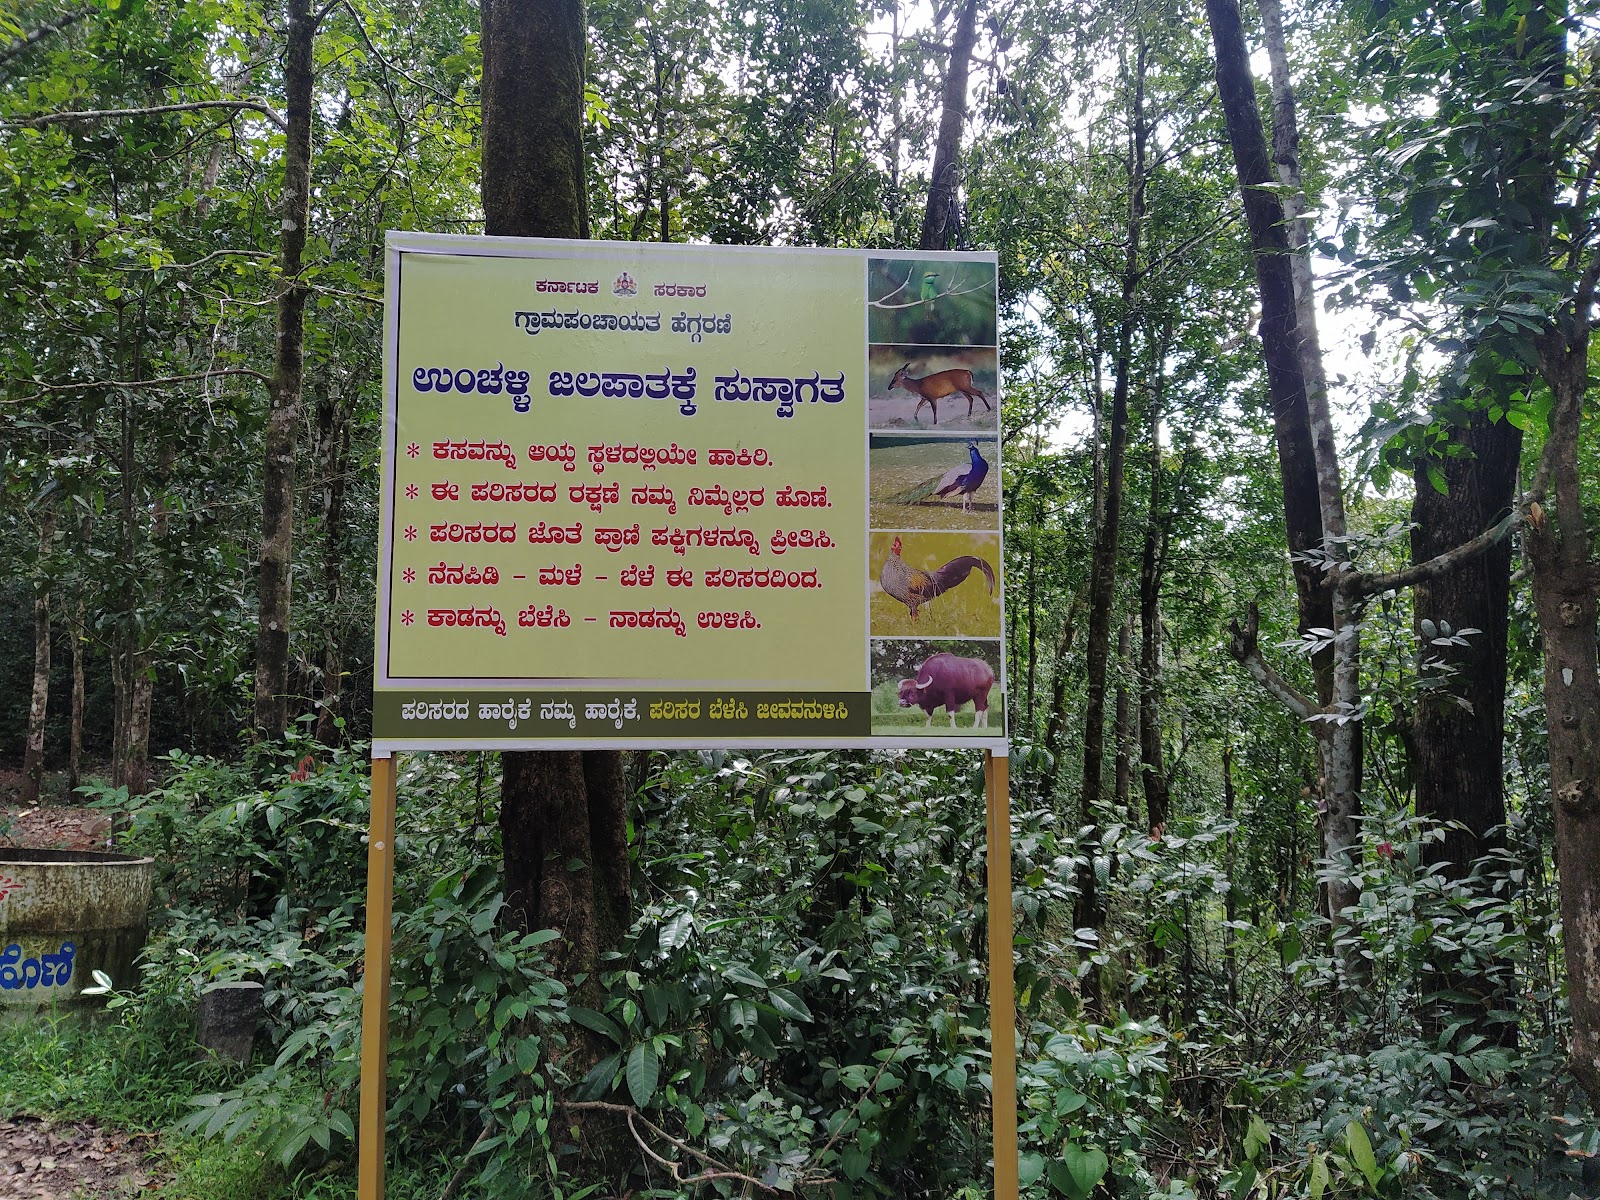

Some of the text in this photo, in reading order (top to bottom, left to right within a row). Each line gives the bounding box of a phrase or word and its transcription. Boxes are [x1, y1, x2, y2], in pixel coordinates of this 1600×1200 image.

[535, 277, 707, 299] ಕರ್ನಾಟಕ ಸರಕಾರ
[514, 308, 732, 343] ಗ್ರಾಮಪಂಚಾಯತ ಹೆಗ್ಗರಣಿ
[412, 361, 846, 419] ಉಂಚಳ್ಳಿ ಜಲಪಾತಕ್ಕೆ ಸುಸ್ವಾಗತ
[432, 438, 774, 475] ಕಸವನ್ನು ಆಯ್ದ ಸ್ಥಳದಲ್ಲಿಯೇ ಹಾಕಿರಿ.
[431, 479, 833, 516] ಈ ಪರಿಸರದ ರಕ್ಷಣೆ ನಮ್ಮ ನಿಮ್ಮೆಲ್ಲರ ಹೊಣೆ.
[429, 521, 837, 557] ಪರಿಸರದ ಜೊತೆ ಪ್ರಾಣಿ ಪಕ್ಷಿಗಳನ್ನೂ ಪ್ರೀತಿಸಿ.
[428, 561, 500, 586] ನೆನಪಿಡಿ
[539, 563, 582, 587] ಮಳೆ
[620, 564, 656, 588] ಬೆಳೆ
[666, 565, 694, 589] ಈ
[704, 566, 823, 590] ಪರಿಸರದಿಂದ.
[427, 604, 507, 636] ಕಾಡನ್ನು
[518, 604, 571, 629] ಬೆಳೆಸಿ
[609, 605, 687, 638] ನಾಡನ್ನು
[696, 608, 761, 630] ಉಳಿಸಿ.
[401, 697, 848, 731] ಪರಿಸರದ ಹಾರೈಕೆ ನಮ್ಮ ಹಾರೈಕೆ, ಪರಿಸರ ಬೆಳೆಸಿ ಜೀವವನುಳಿಸಿ
